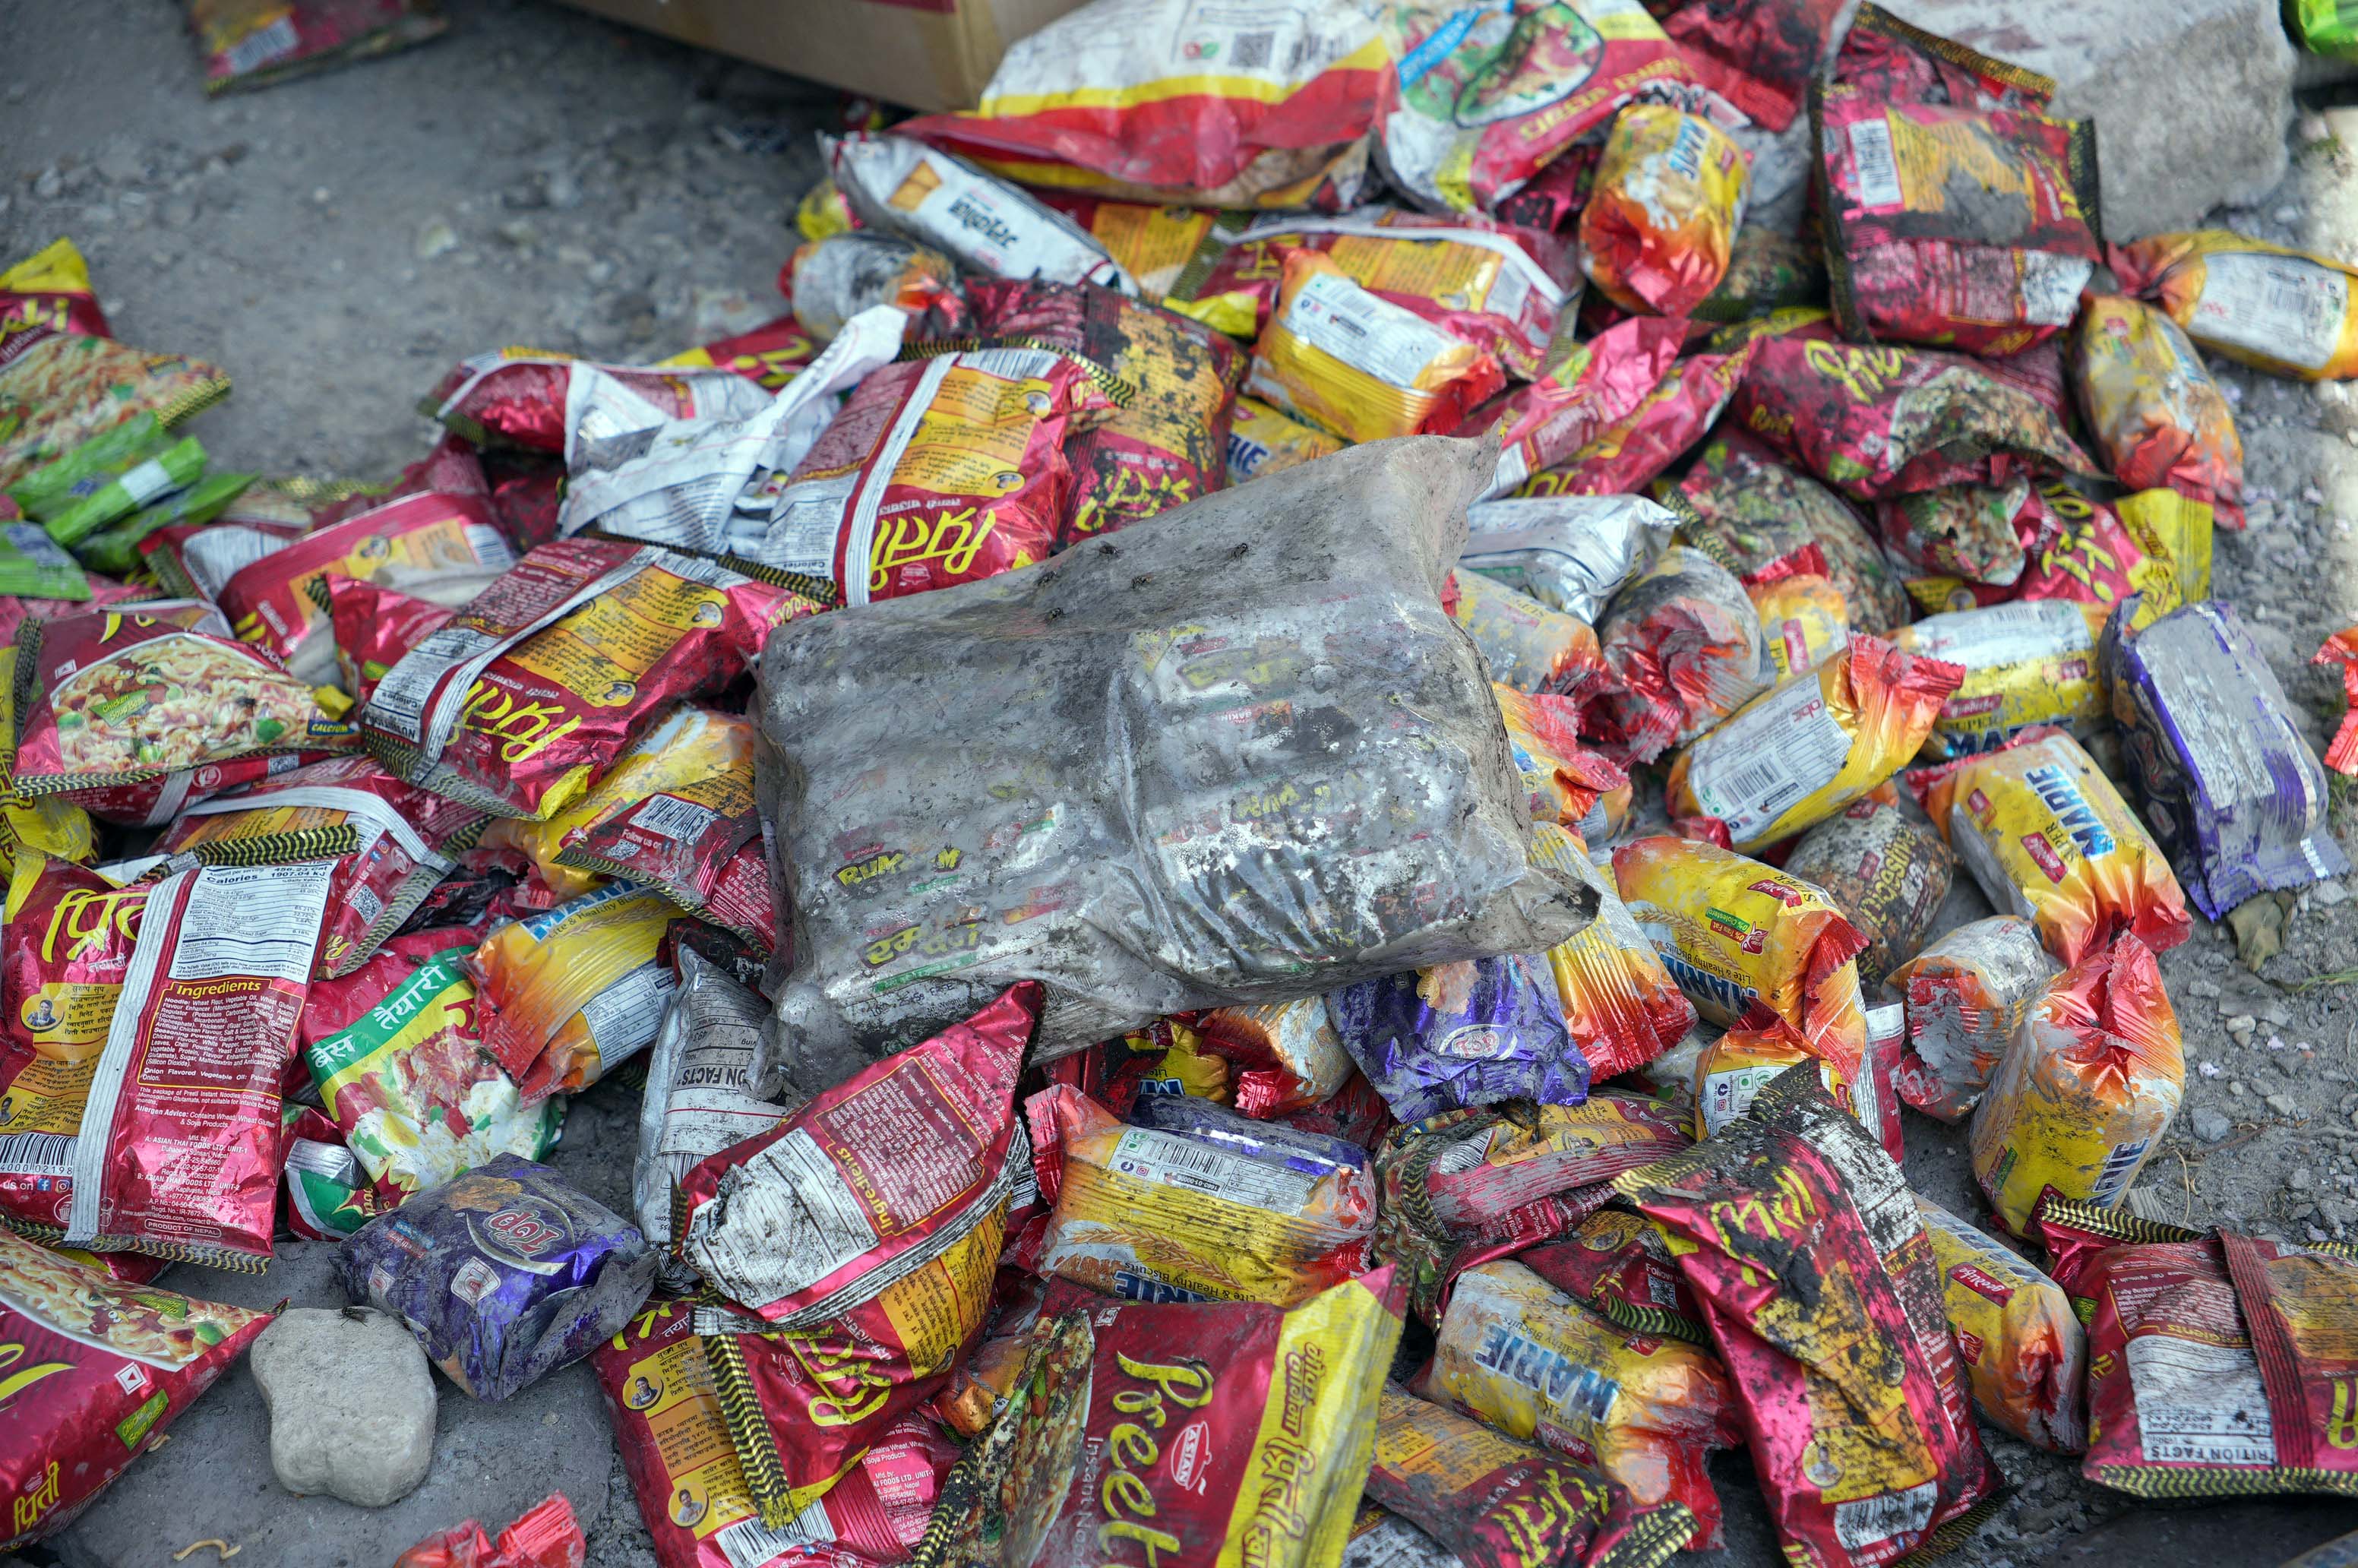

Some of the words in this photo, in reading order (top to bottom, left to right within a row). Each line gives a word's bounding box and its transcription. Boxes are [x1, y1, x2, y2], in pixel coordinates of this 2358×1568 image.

[103, 693, 129, 713] Chicken
[110, 703, 128, 720] Soup
[130, 694, 146, 712] Base
[311, 723, 348, 732] CALCIUM
[2025, 764, 2115, 859] MARIE
[622, 830, 643, 844] Follow
[643, 836, 652, 846] us
[838, 853, 903, 887] RUM
[342, 880, 362, 904] Follow
[359, 871, 369, 884] us
[367, 861, 376, 872] on
[548, 923, 567, 938] Lite
[577, 902, 616, 920] Healthy
[1665, 942, 1693, 963] Biscuits
[1693, 957, 1724, 975] Healthy
[1734, 972, 1751, 985] Lite
[177, 982, 261, 999] Ingredients
[213, 1003, 244, 1012] (Monosodium
[261, 995, 277, 1005] Wheat
[310, 1035, 356, 1068] बेस
[373, 965, 447, 1029] तैयारी
[154, 1027, 188, 1037] Seasoning
[191, 1032, 218, 1041] Powder:
[156, 1023, 178, 1031] Artificial
[199, 1057, 233, 1066] Maltodextrin
[204, 1051, 223, 1059] Flavour
[201, 1071, 232, 1080] Vegetable
[135, 1105, 163, 1114] Allergen
[238, 1115, 257, 1124] Wheat
[258, 1119, 274, 1128] Gluten
[228, 1146, 247, 1154] UNIT-1
[182, 1178, 203, 1187] FOODS
[220, 1182, 240, 1190] UNIT-2
[836, 1147, 893, 1230] Ingredients
[148, 1222, 182, 1231] PRODUCT
[1125, 1262, 1170, 1282] Biscuits
[1645, 1263, 1673, 1279] Follow
[1174, 1276, 1219, 1296] Healthy
[1222, 1290, 1231, 1300] &
[1475, 1323, 1621, 1424] MARIE
[121, 1405, 148, 1436] Chicken
[129, 1425, 148, 1445] Soup
[144, 1401, 165, 1428] Base
[867, 1456, 881, 1465] Soya
[882, 1452, 907, 1460] Products.
[1179, 1429, 1200, 1483] ASIAN
[2151, 1446, 2203, 1457] FACTS
[880, 1478, 899, 1487] FOODS
[901, 1474, 914, 1483] LTD.
[916, 1470, 934, 1479] UNIT-1
[1081, 1437, 1103, 1503] Instant
[789, 1554, 804, 1564] on
